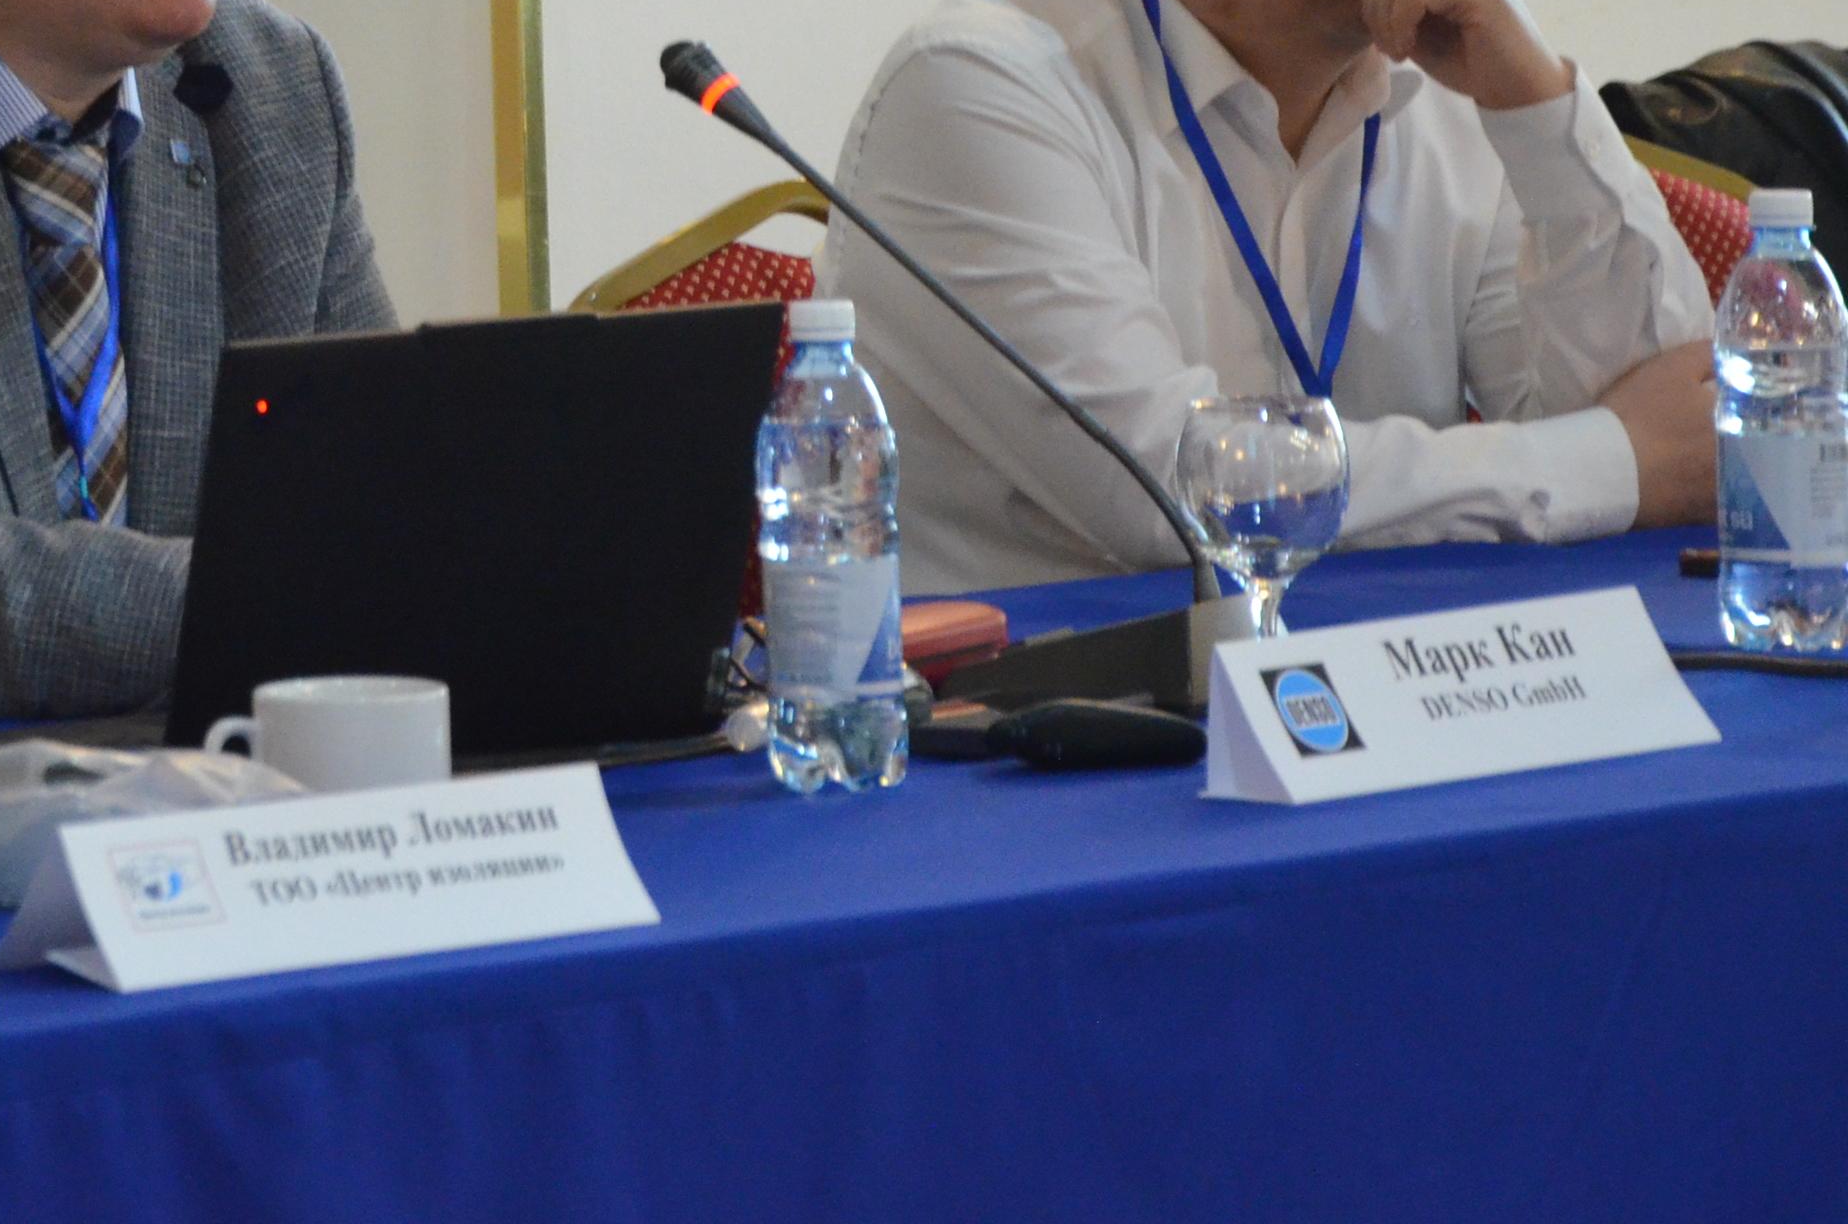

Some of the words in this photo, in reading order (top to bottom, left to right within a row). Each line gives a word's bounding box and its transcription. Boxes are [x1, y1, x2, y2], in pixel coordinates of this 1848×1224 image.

[1382, 637, 1493, 684] Марк
[1495, 623, 1576, 664] Кан
[1420, 686, 1509, 721] DENSO
[1511, 674, 1587, 709] GmbH
[224, 823, 398, 866] Владимир
[408, 805, 559, 846] Ломакин
